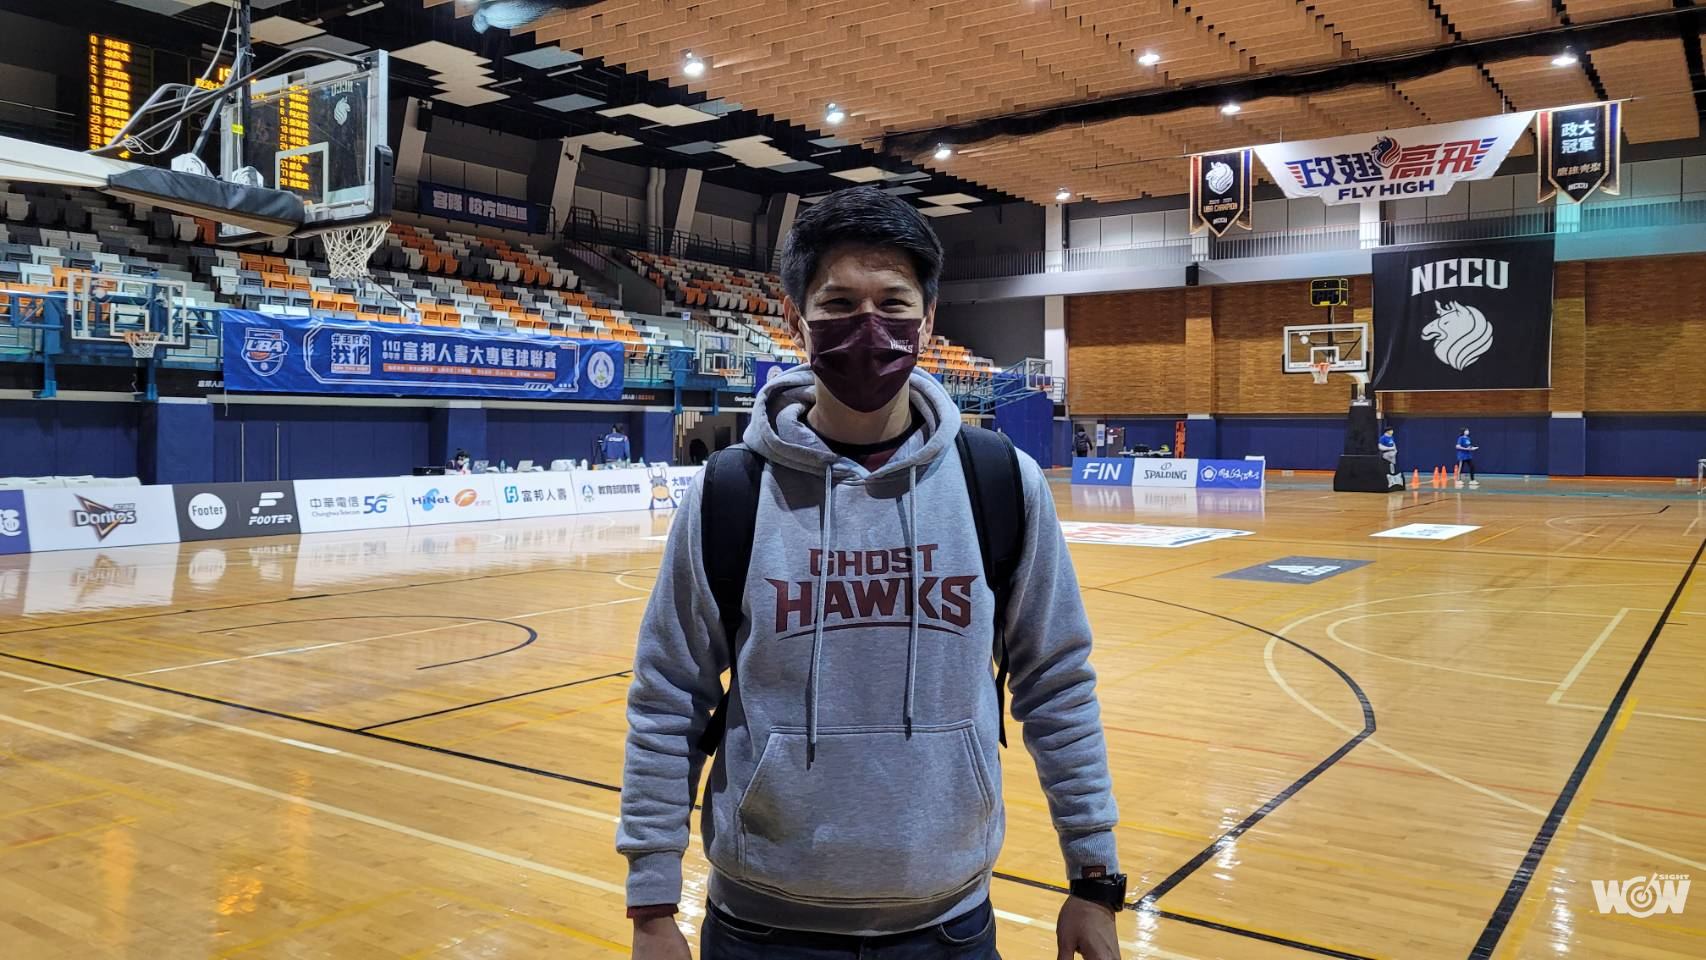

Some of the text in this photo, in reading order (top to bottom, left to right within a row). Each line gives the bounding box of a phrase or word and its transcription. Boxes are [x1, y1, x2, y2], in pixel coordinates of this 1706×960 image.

[1560, 120, 1596, 137] 政大
[1561, 136, 1596, 154] 冠軍
[1338, 180, 1435, 200] FLY HIGH
[1411, 257, 1510, 296] NCCU
[246, 339, 283, 352] UBA
[382, 340, 401, 352] 110
[403, 341, 557, 369] 富邦人壽大專籃球聯賽
[1082, 463, 1122, 481] FIN
[1144, 469, 1188, 480] SPALDING
[411, 495, 451, 505] HiNet
[521, 488, 568, 503] 富邦人壽
[192, 505, 224, 516] Footer
[309, 495, 388, 514] 中華電信 5G
[75, 510, 137, 526] Doritos
[248, 514, 293, 525] FOOTER
[808, 543, 938, 577] GHOST
[764, 575, 979, 634] HAWKS
